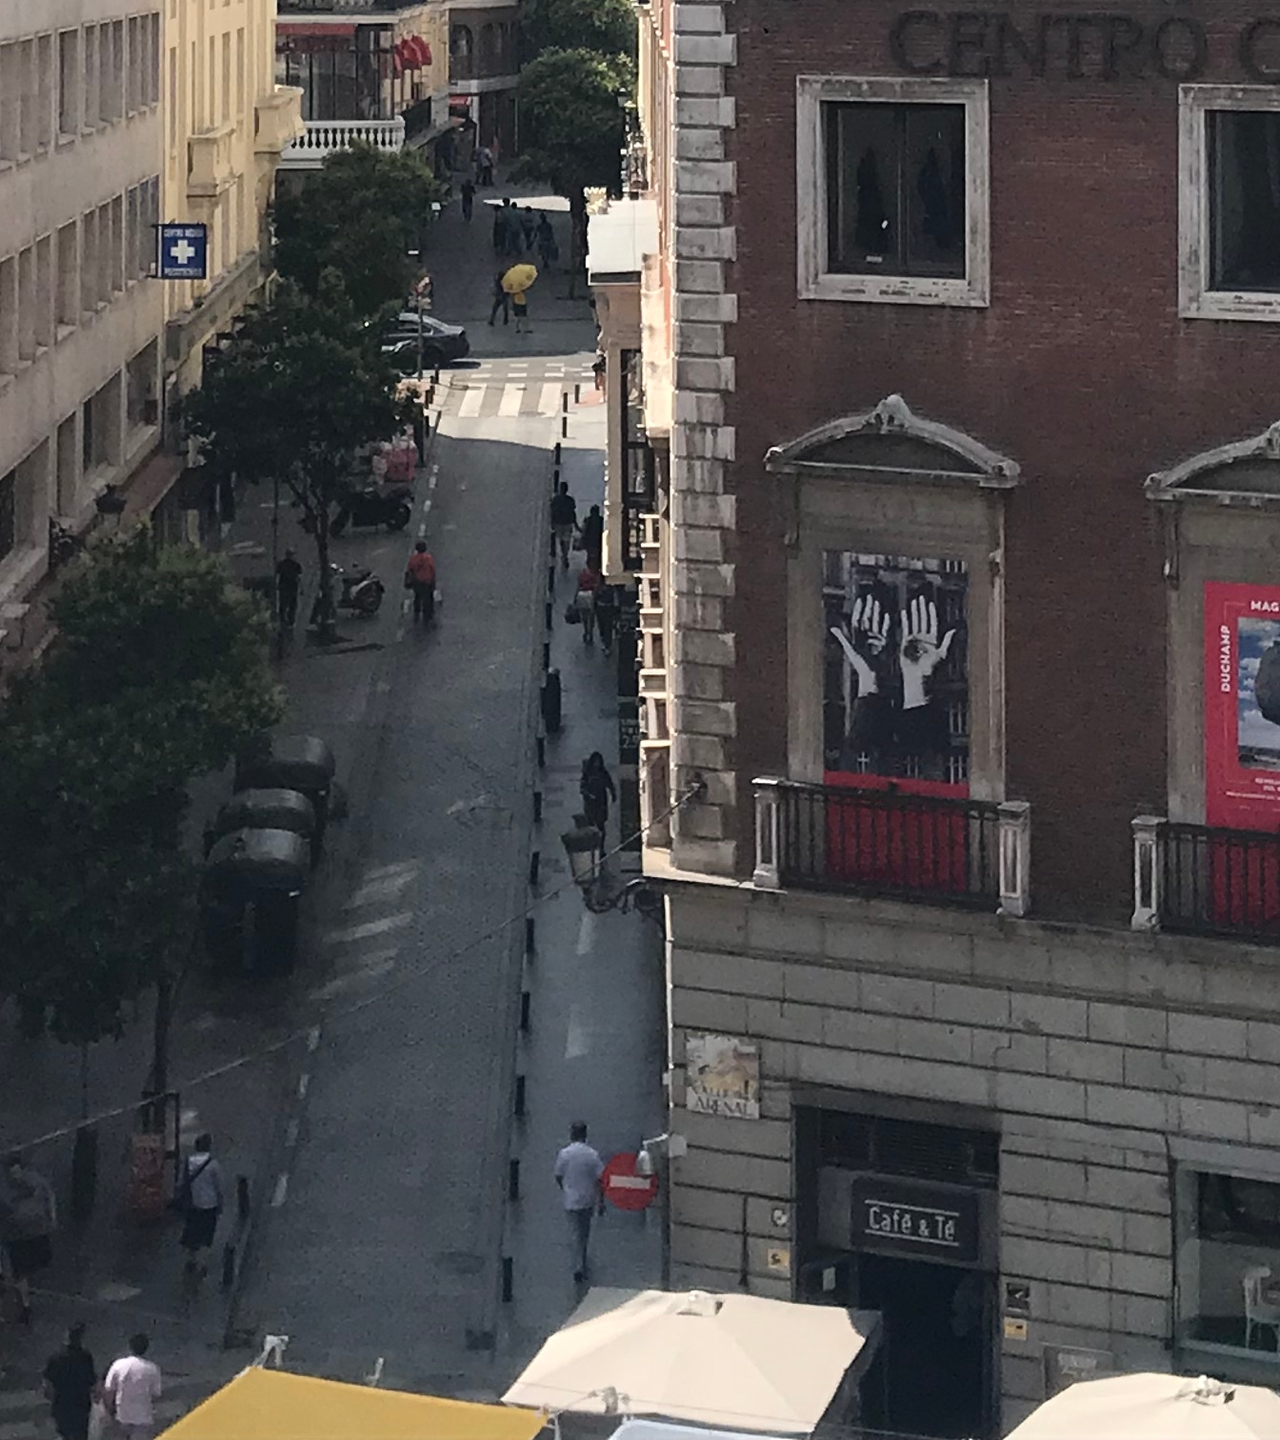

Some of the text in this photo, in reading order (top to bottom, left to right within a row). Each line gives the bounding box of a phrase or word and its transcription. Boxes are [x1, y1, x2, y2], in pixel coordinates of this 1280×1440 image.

[889, 9, 1207, 80] CENTRO
[1220, 625, 1232, 693] DUCHAMP
[869, 1206, 955, 1241] Café & Té
